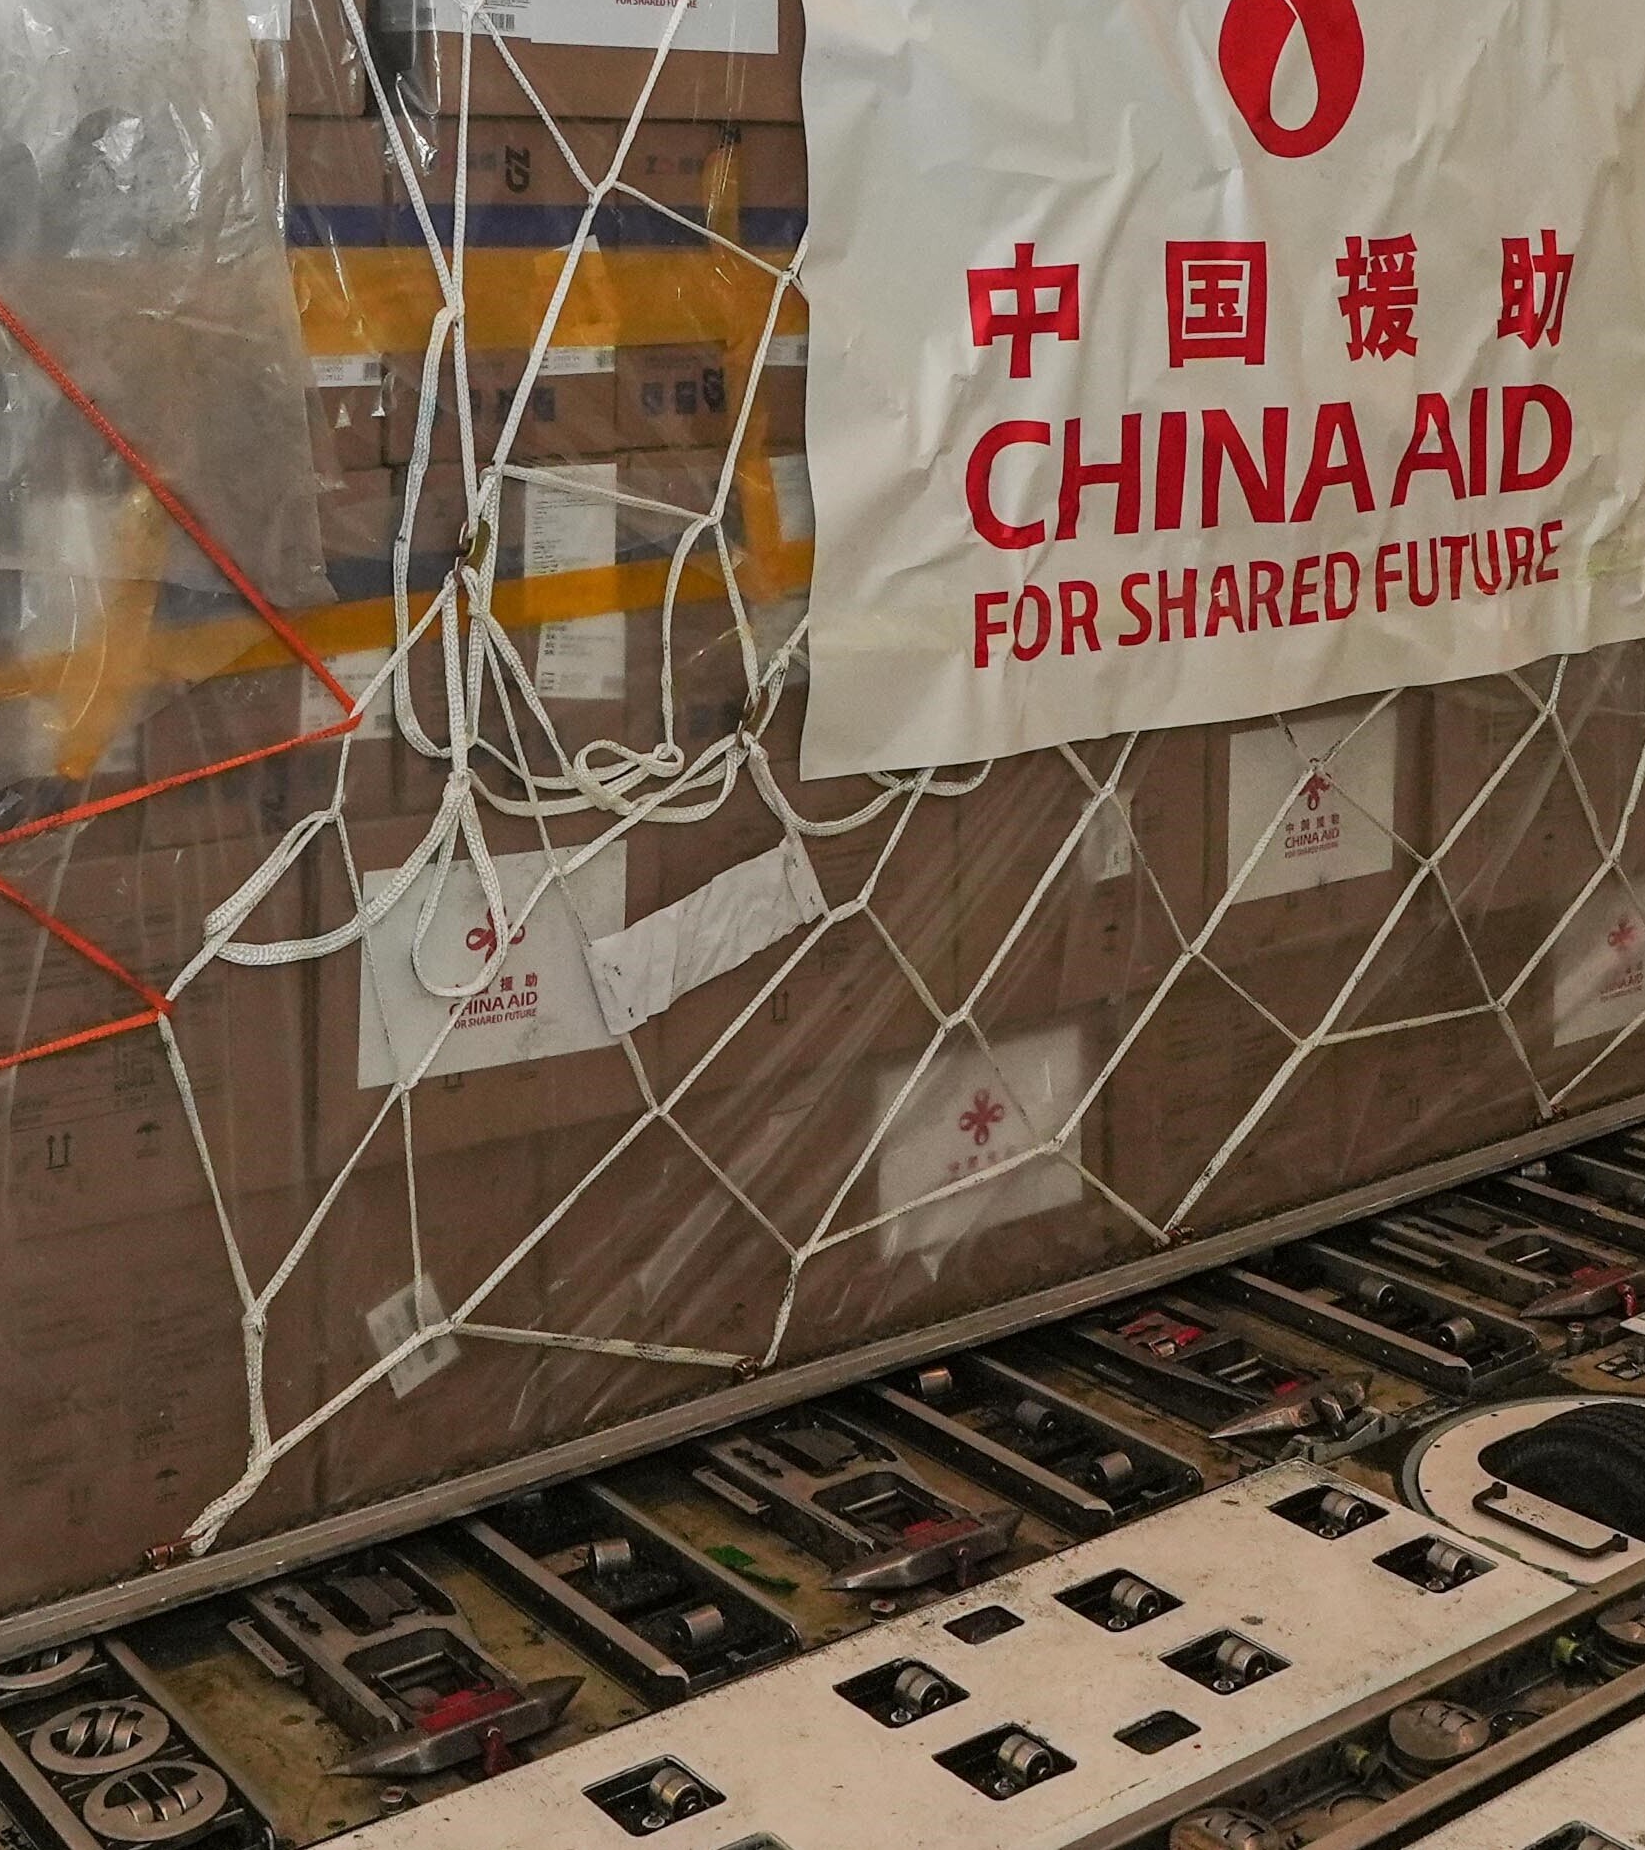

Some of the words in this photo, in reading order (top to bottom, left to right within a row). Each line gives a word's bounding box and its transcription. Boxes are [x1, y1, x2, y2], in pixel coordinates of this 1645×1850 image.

[967, 229, 1575, 379] 中国援助
[965, 401, 1375, 550] CHINA
[1390, 383, 1574, 508] AID
[974, 583, 1101, 668] FOR
[1118, 550, 1360, 647] SHARED
[1375, 519, 1563, 613] FUTURE
[1285, 832, 1319, 849] CHINA
[508, 991, 538, 1009] AID
